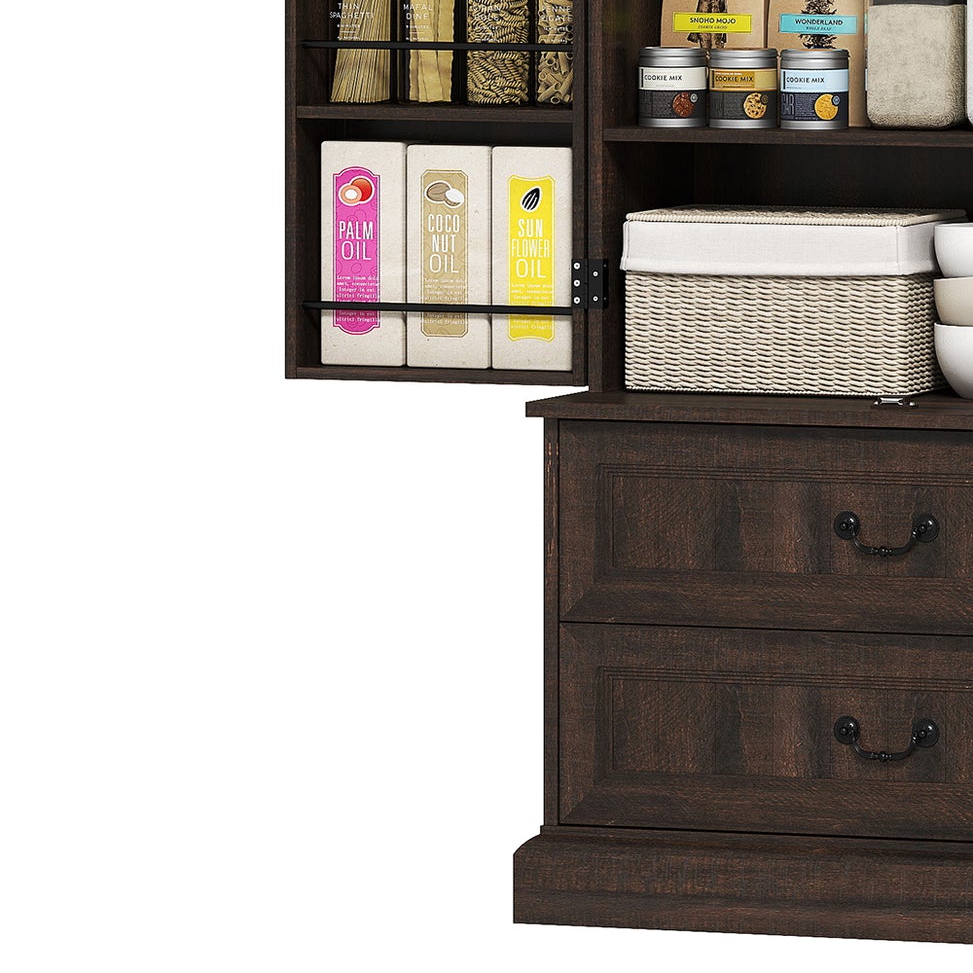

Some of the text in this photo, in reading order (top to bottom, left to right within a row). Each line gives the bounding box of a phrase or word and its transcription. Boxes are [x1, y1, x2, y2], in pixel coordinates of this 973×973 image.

[329, 11, 374, 19] SPAGHETTI
[339, 221, 373, 239] PALM
[428, 214, 459, 233] COCO
[518, 218, 543, 237] SUN
[341, 241, 371, 260] OIL
[432, 234, 456, 253] NUT
[511, 239, 550, 258] FLOWER
[429, 254, 459, 273] OIL
[516, 259, 546, 278] OIL
